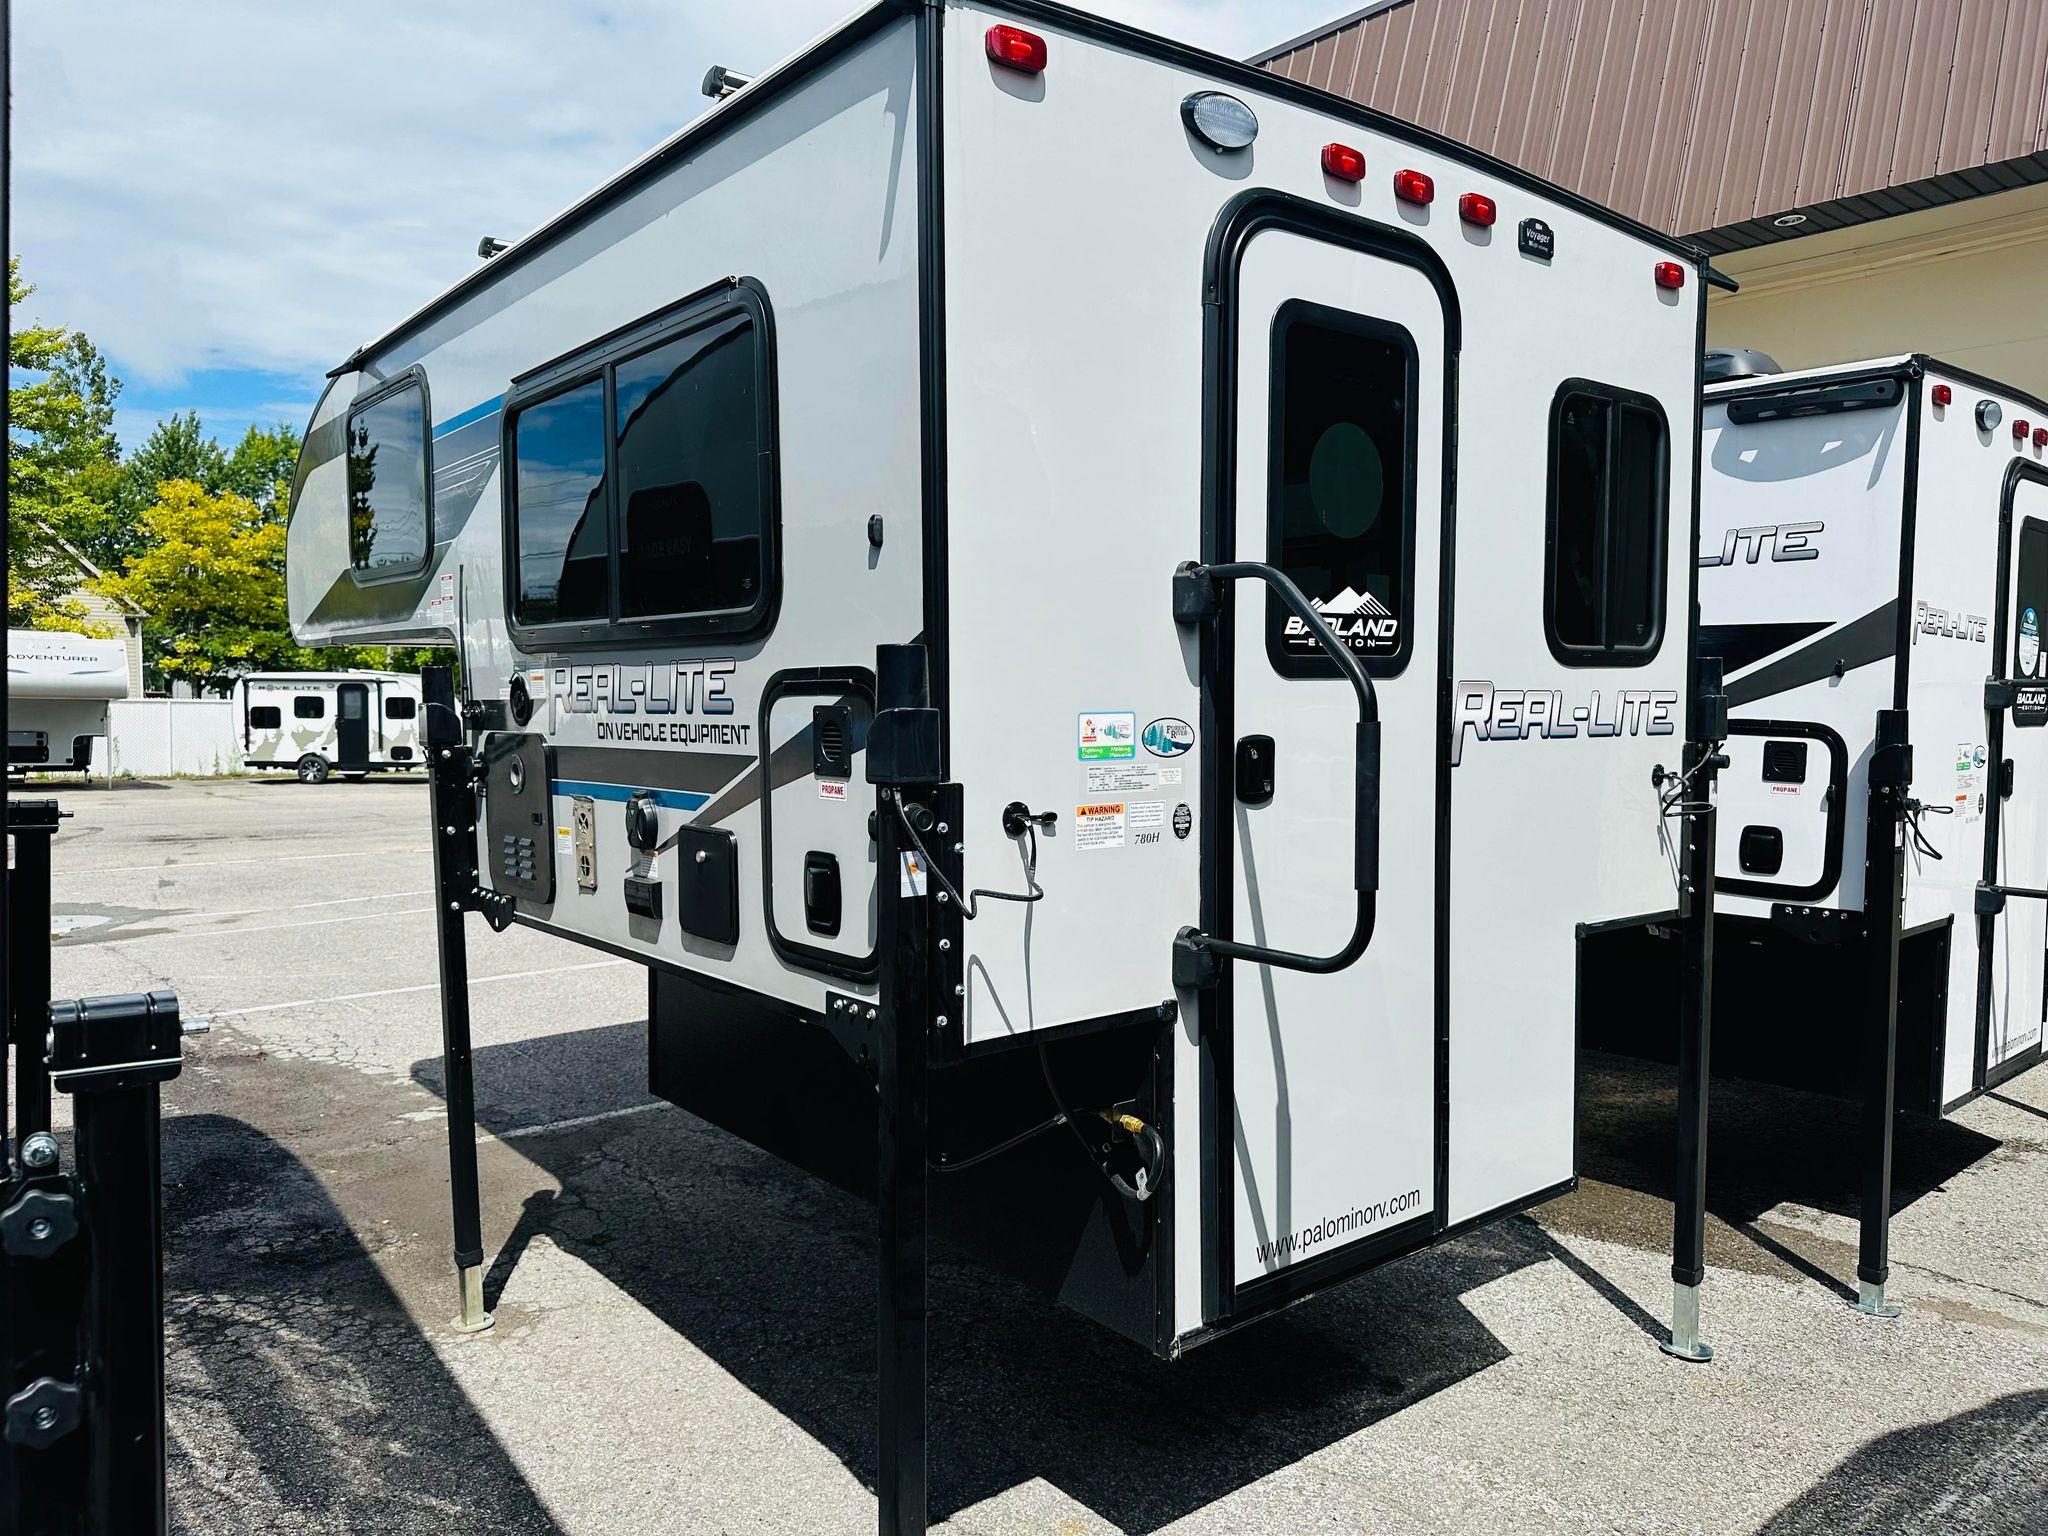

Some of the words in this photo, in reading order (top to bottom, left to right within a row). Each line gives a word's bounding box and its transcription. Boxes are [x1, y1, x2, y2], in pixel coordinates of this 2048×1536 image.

[1526, 228, 1551, 243] Voyager
[1912, 600, 1988, 646] REAL-LITE
[1308, 638, 1376, 647] EION
[548, 656, 736, 735] REAL-LITE
[2016, 693, 2047, 705] BADLAND
[1166, 726, 1188, 734] FOREST
[1450, 680, 1678, 767] REAL-LITE
[597, 722, 614, 740] ON
[615, 722, 667, 742] VEHICLE
[670, 723, 751, 747] EQUIPMENT
[821, 784, 844, 796] PROPANE
[1088, 805, 1121, 814] WARNING
[1134, 832, 1160, 845] 780H
[1256, 1189, 1420, 1264] www.palominorv.com
